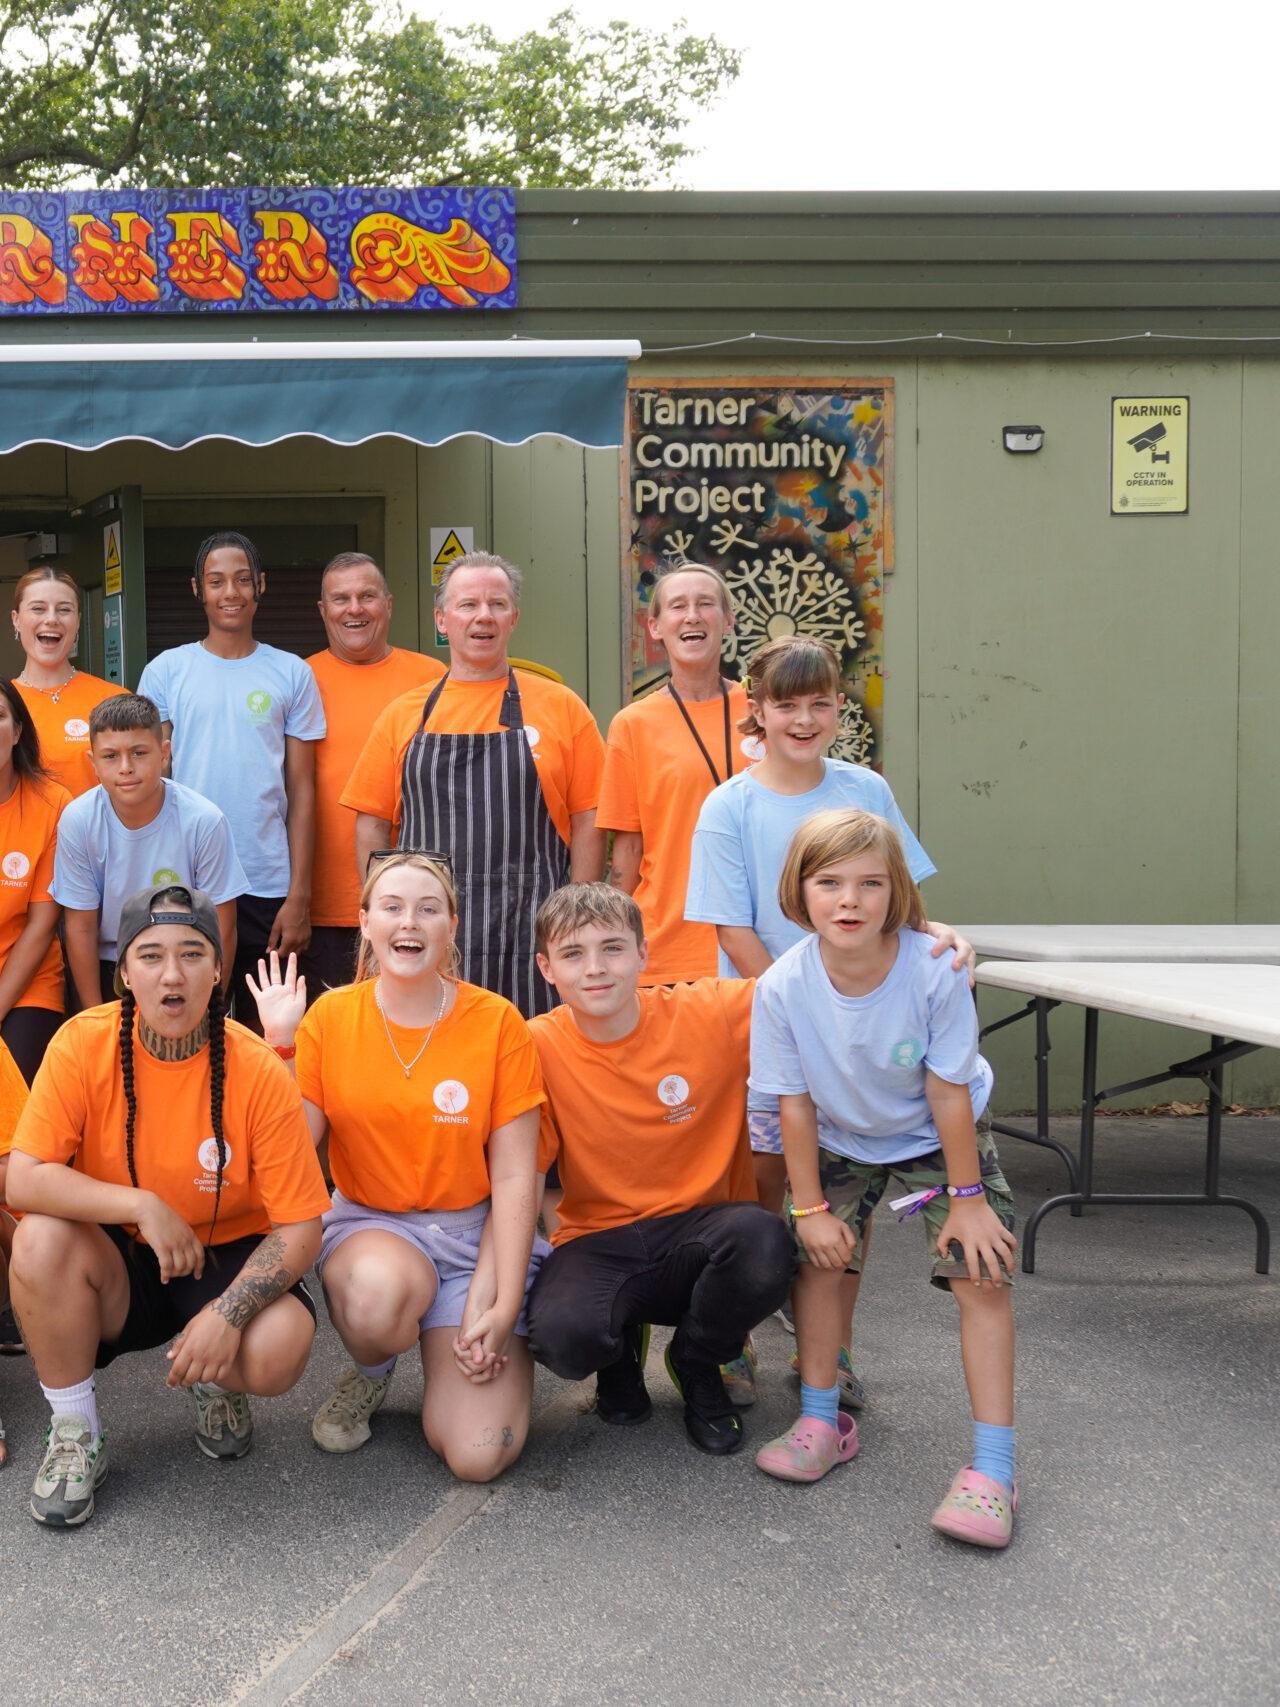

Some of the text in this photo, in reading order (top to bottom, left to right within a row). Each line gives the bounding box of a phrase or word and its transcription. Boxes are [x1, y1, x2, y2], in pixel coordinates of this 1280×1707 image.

[638, 391, 756, 425] Tarner
[1120, 405, 1181, 416] WARNING
[636, 434, 846, 478] Community
[636, 477, 766, 522] Project
[432, 1115, 470, 1124] TARNER
